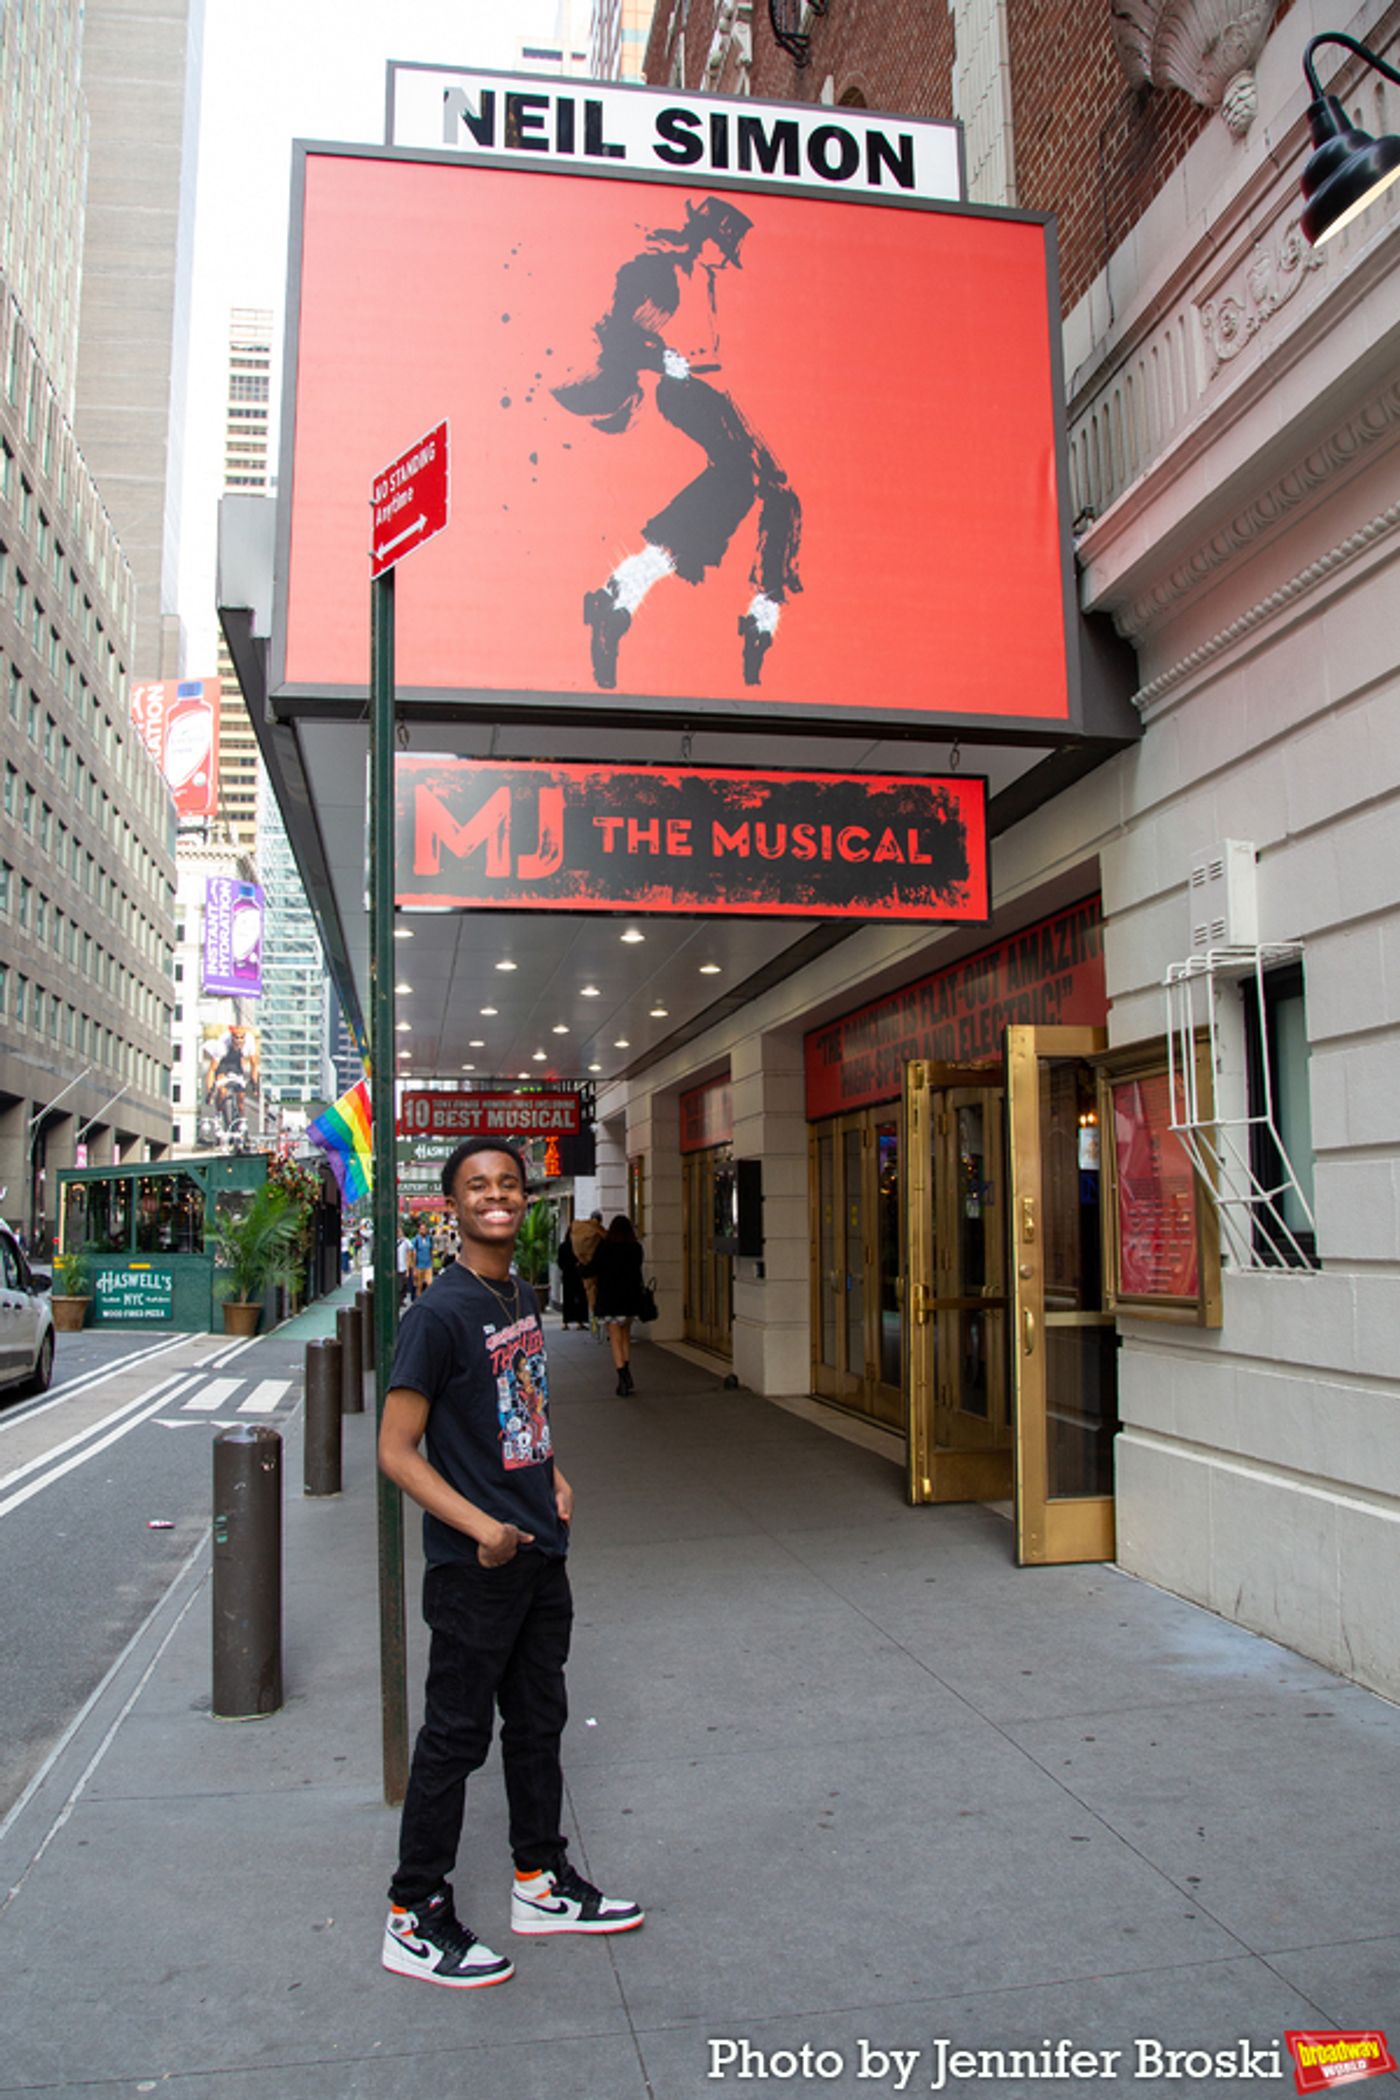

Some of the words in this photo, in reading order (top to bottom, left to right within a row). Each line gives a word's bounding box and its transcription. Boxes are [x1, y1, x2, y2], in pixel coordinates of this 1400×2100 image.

[443, 86, 626, 160] NEIL
[653, 106, 916, 190] SIMON
[375, 480, 388, 504] NO
[389, 441, 436, 493] STANDING
[375, 487, 414, 527] Anytime
[413, 783, 566, 882] MJ
[592, 815, 693, 857] THE
[712, 820, 933, 865] MUSICAL
[207, 901, 218, 976] INSTANT
[219, 879, 232, 977] HYDRATION
[901, 993, 918, 1035] IS
[919, 954, 1001, 1031] FLAT-OUT
[1006, 903, 1103, 992] AMAZIN
[405, 1098, 430, 1129] 10
[433, 1110, 482, 1129] BEST
[487, 1110, 576, 1129] MUSICAL
[123, 1293, 145, 1306] NYC
